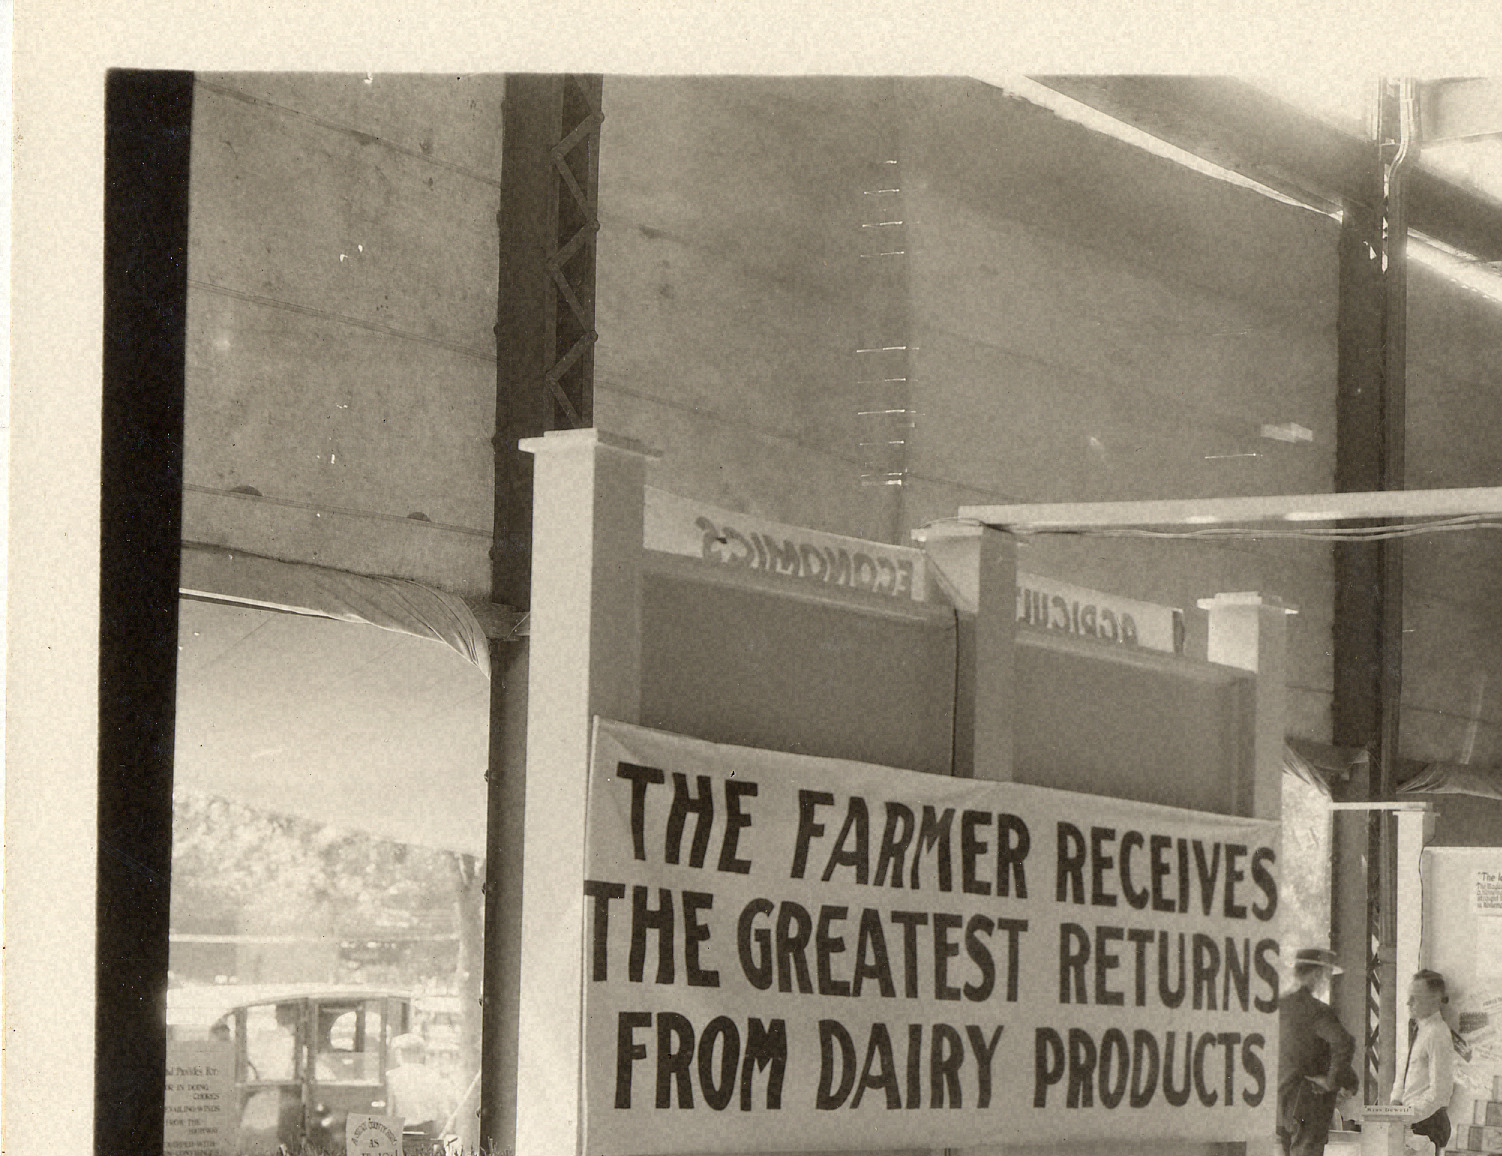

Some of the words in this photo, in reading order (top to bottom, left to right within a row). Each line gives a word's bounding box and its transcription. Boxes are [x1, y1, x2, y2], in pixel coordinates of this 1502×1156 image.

[615, 761, 758, 875] THE
[790, 788, 1032, 900] FARMER
[1055, 820, 1279, 922] RECEIVES
[583, 880, 721, 988] THE
[737, 897, 1029, 1004] GREATEST
[1059, 922, 1282, 1014] RETURNS
[614, 1011, 788, 1113] FROM
[815, 1018, 1005, 1112] DAIRY
[1033, 1026, 1267, 1109] PRODUCTS
